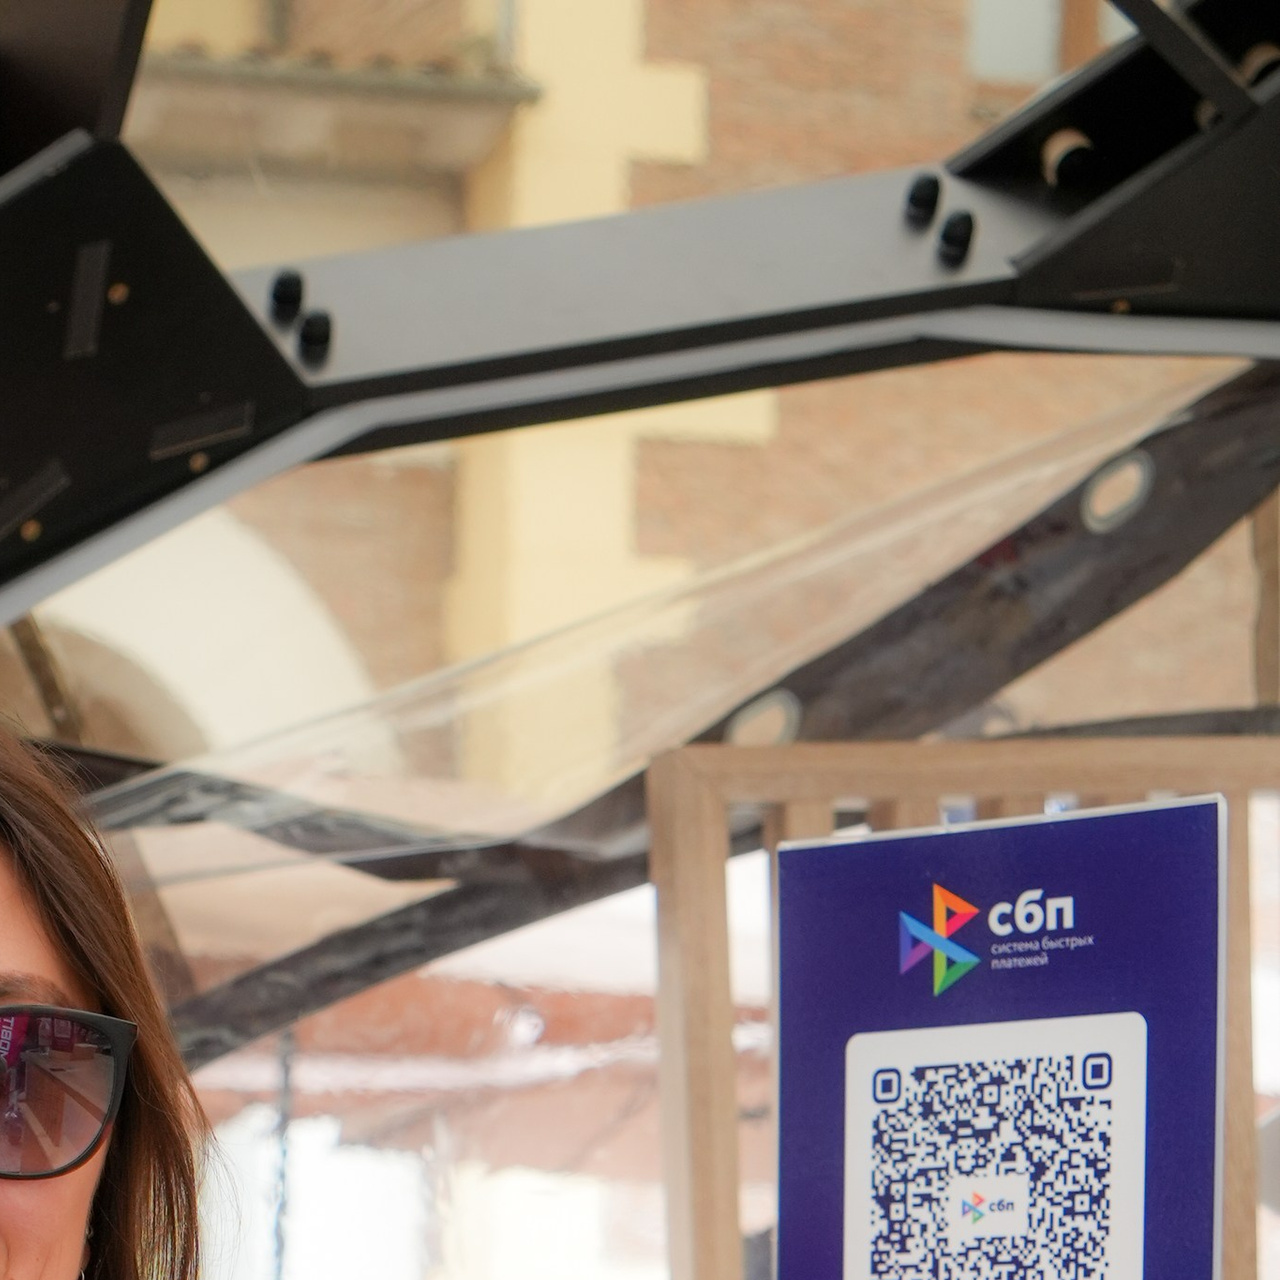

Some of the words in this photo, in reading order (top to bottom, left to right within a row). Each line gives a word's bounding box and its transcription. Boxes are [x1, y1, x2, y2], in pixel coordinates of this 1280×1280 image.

[987, 888, 1074, 937] сбп
[991, 937, 1040, 954] система
[1041, 935, 1095, 952] быстрых
[991, 952, 1048, 970] платежей
